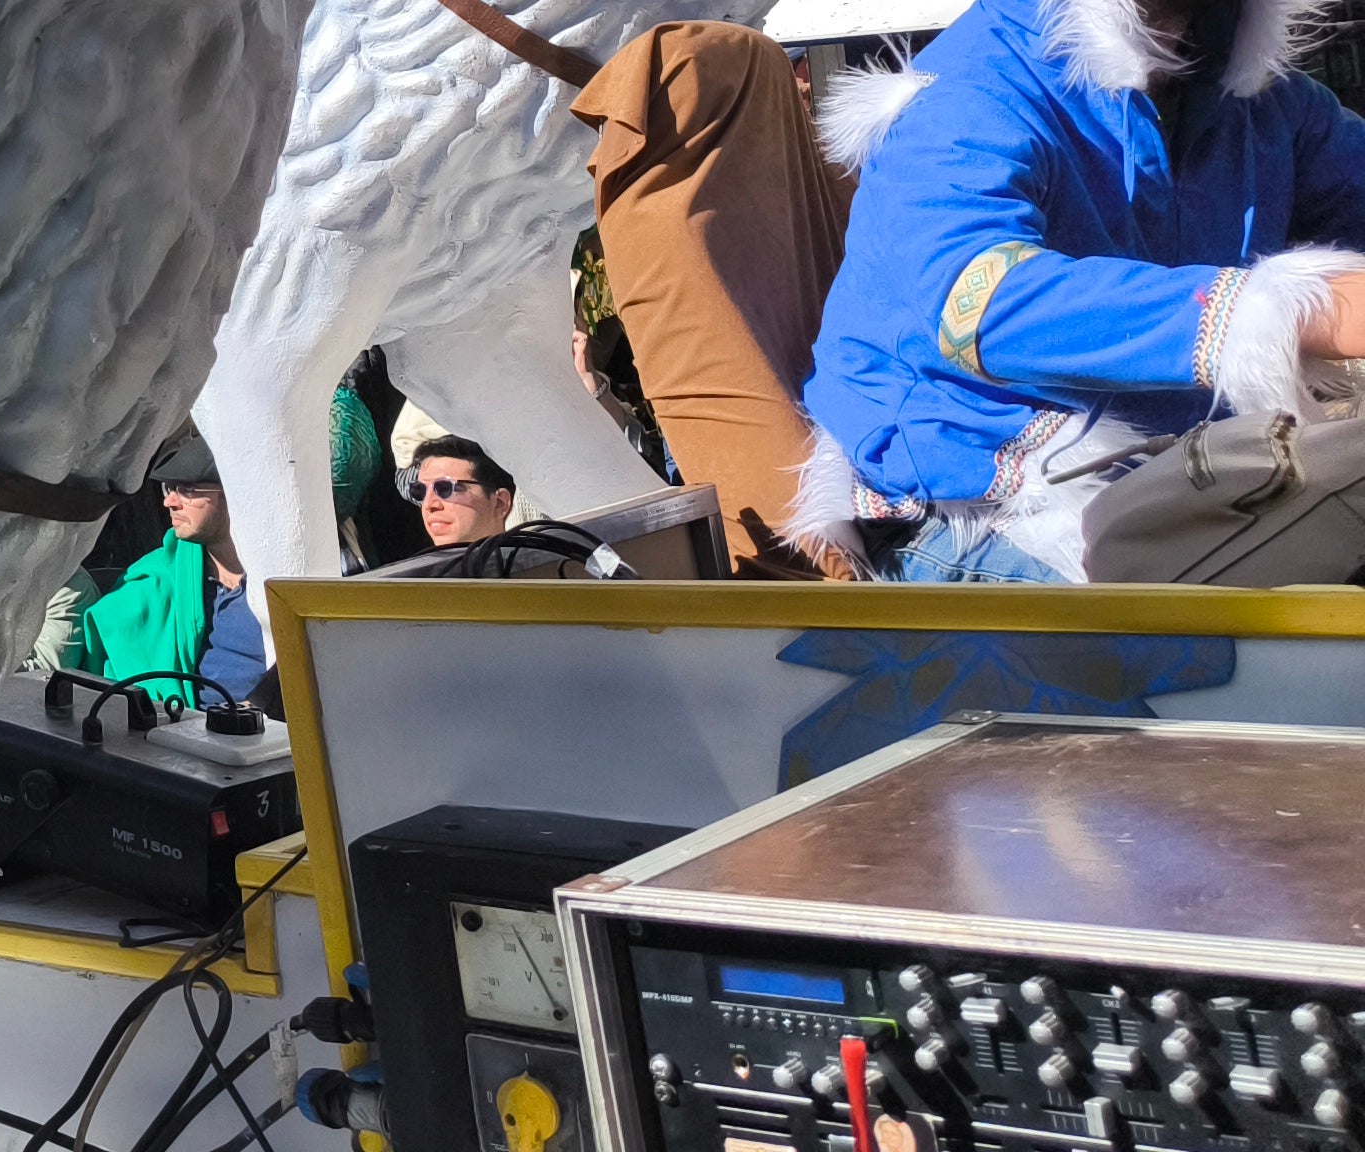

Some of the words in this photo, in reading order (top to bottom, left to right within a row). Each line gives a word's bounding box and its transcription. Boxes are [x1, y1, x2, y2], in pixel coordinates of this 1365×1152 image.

[256, 789, 270, 818] 3
[112, 827, 136, 843] MF
[141, 837, 184, 860] 1500
